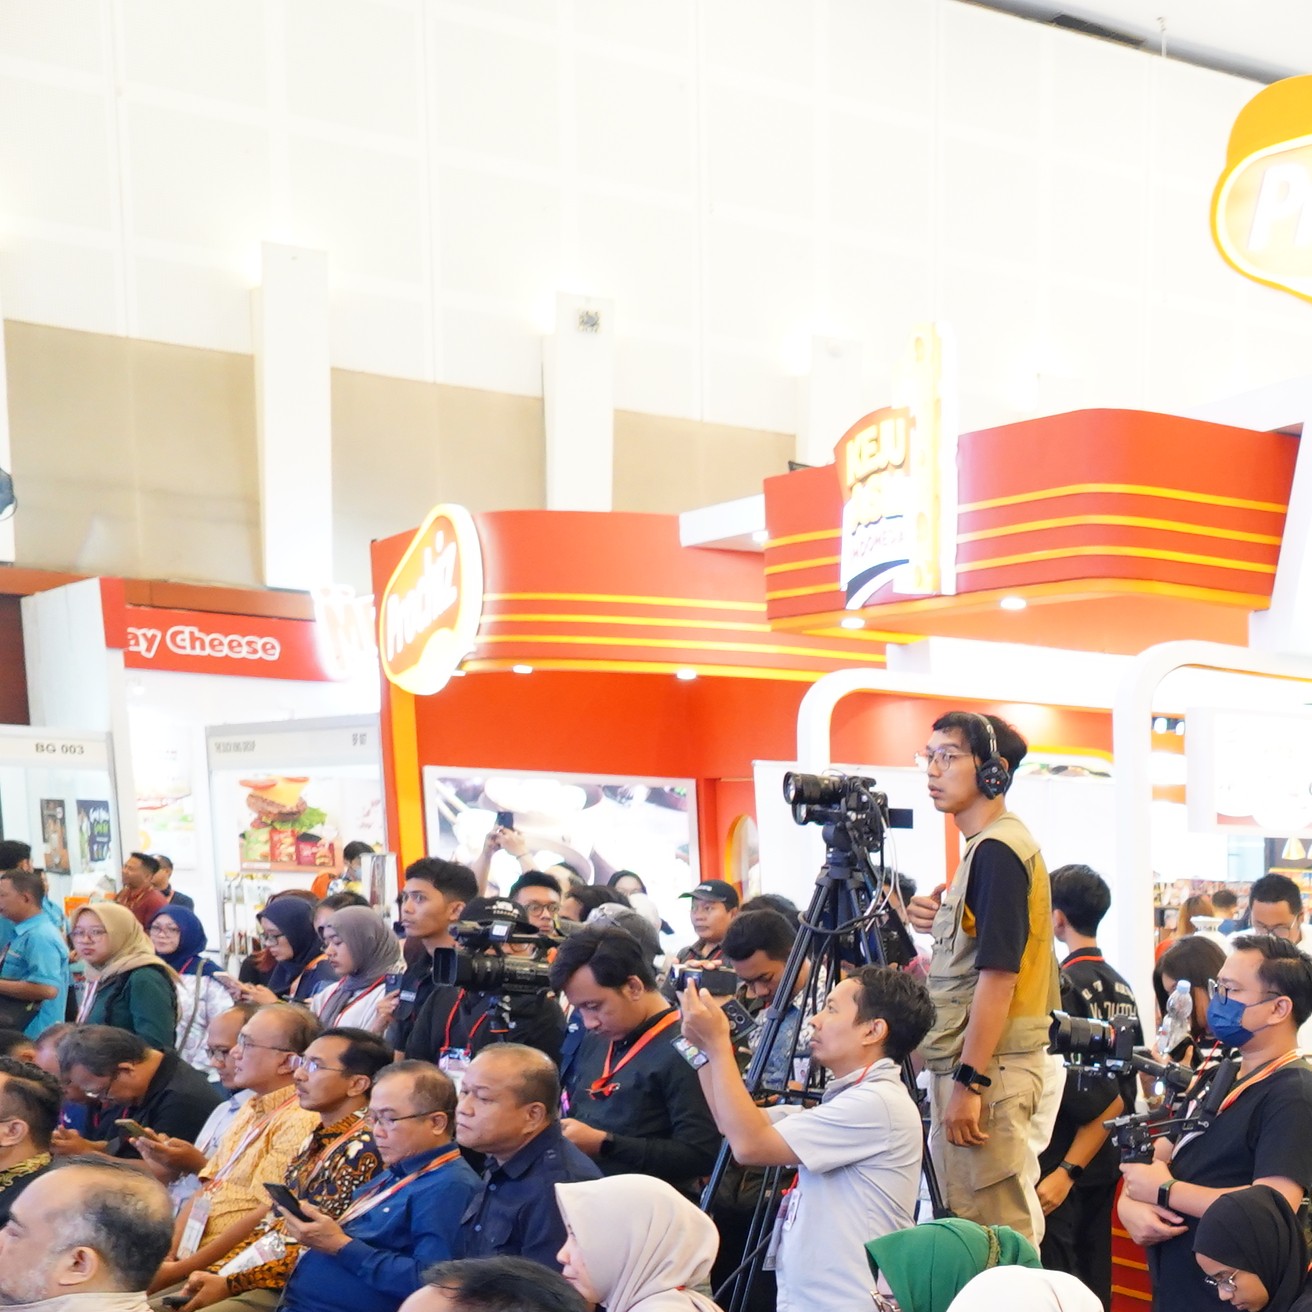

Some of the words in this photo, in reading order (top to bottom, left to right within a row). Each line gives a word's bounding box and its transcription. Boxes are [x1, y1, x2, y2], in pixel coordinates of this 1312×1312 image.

[165, 625, 281, 661] Cheese
[35, 743, 56, 753] BG
[61, 744, 84, 754] 003
